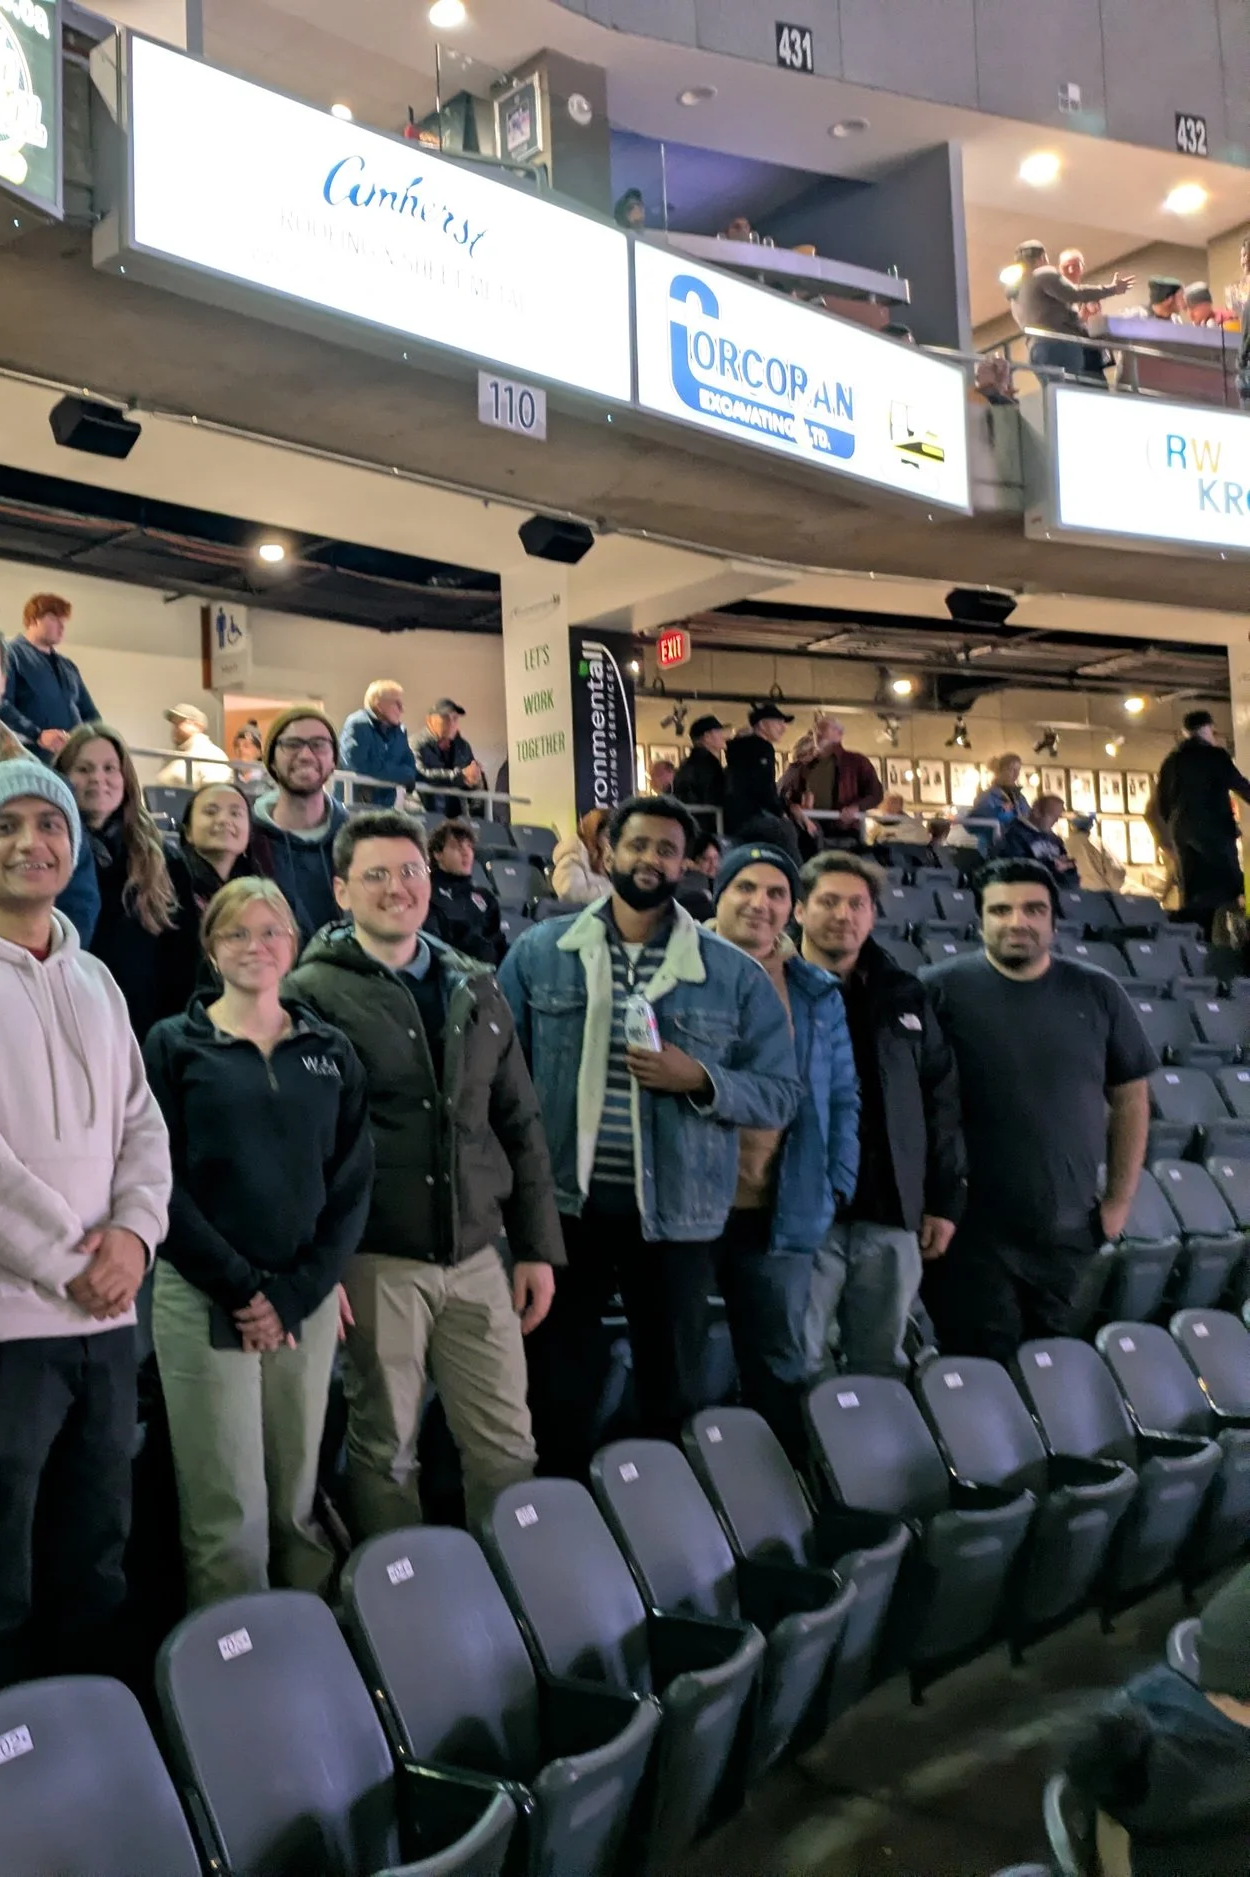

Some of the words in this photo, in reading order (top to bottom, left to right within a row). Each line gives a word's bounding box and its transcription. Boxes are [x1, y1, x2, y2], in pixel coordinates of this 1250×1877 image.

[779, 26, 813, 70] 431
[1177, 115, 1207, 156] 432
[489, 380, 536, 429] 110
[1166, 433, 1222, 474] RW
[1198, 477, 1250, 517] KR
[660, 636, 683, 663] EXIT
[523, 688, 555, 716] WORK
[516, 731, 567, 762] TOGETHER
